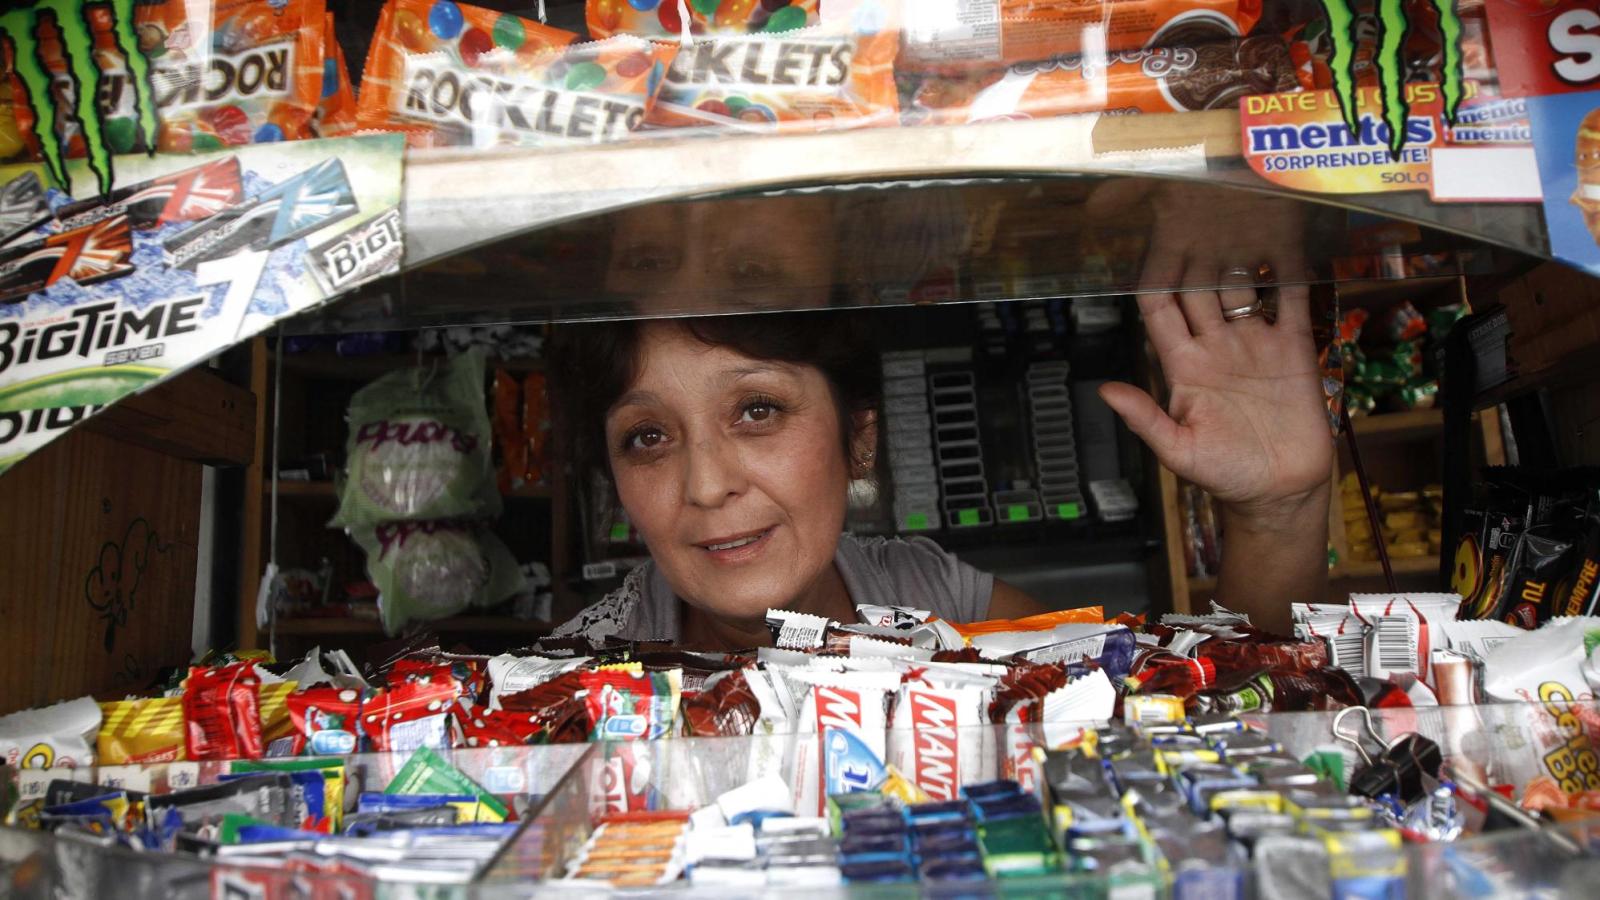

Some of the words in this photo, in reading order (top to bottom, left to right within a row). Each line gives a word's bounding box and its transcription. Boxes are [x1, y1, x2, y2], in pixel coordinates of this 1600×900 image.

[1247, 91, 1317, 115] DATE
[1381, 172, 1429, 184] SOLO
[1522, 581, 1547, 603] TU
